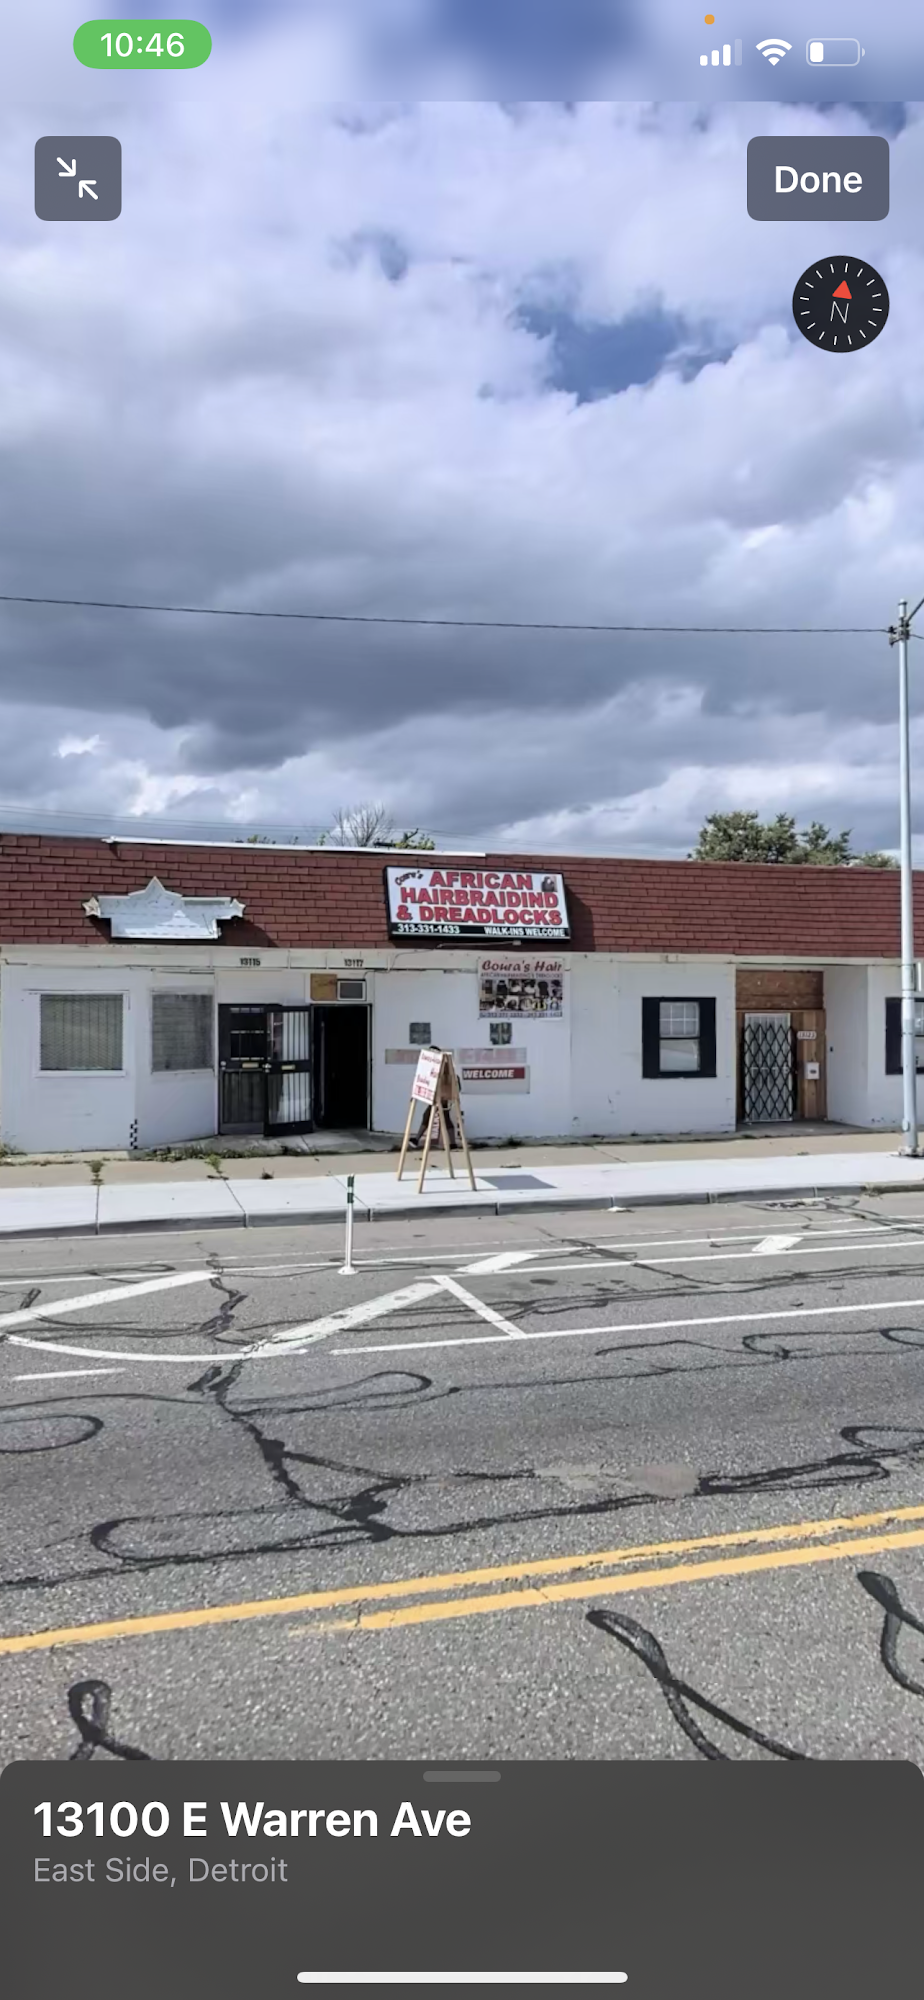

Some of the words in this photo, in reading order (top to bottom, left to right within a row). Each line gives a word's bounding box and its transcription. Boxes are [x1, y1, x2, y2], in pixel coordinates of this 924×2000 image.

[429, 871, 533, 889] AFRICAN
[400, 887, 558, 908] HAIRBRAIDIND
[396, 905, 413, 921] &
[419, 906, 562, 925] DREADLOCKS
[397, 923, 460, 934] 313-331-1433
[484, 926, 524, 936] WALK-INS
[525, 928, 565, 937] WELCOME
[239, 957, 261, 966] 13115
[344, 958, 364, 967] 13117
[534, 961, 562, 972] Hair
[463, 1069, 514, 1079] WELCOME
